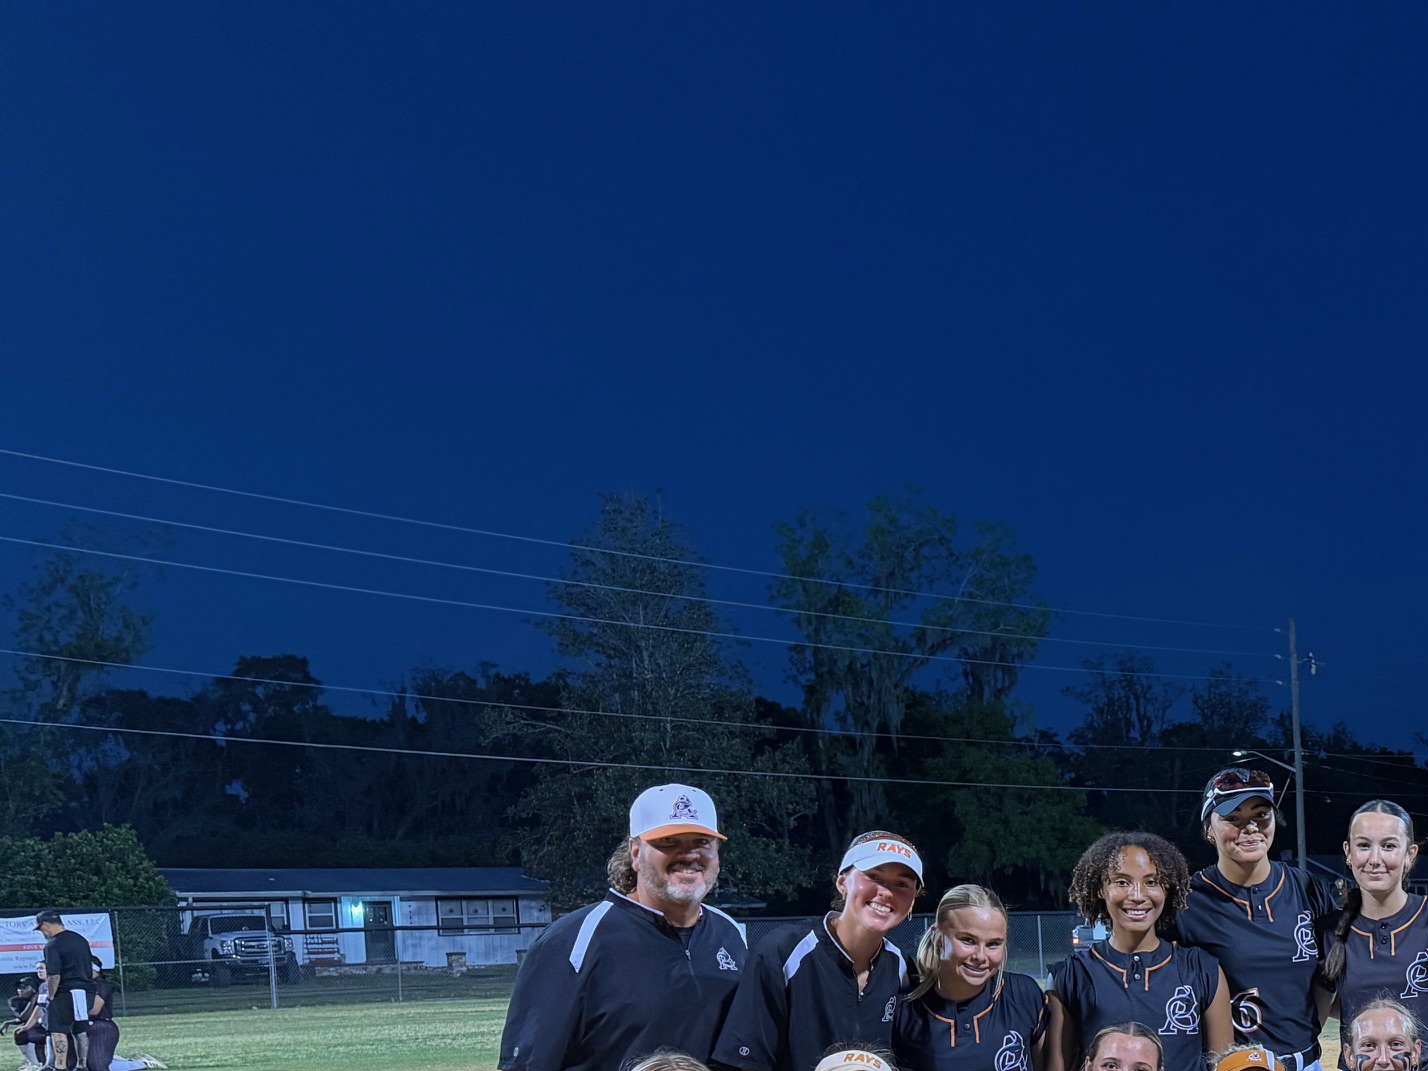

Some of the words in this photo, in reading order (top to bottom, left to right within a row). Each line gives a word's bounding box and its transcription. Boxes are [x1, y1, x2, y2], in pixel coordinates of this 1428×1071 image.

[877, 842, 911, 859] RAYS
[1230, 987, 1262, 1033] 6
[843, 1053, 882, 1070] RAYS
